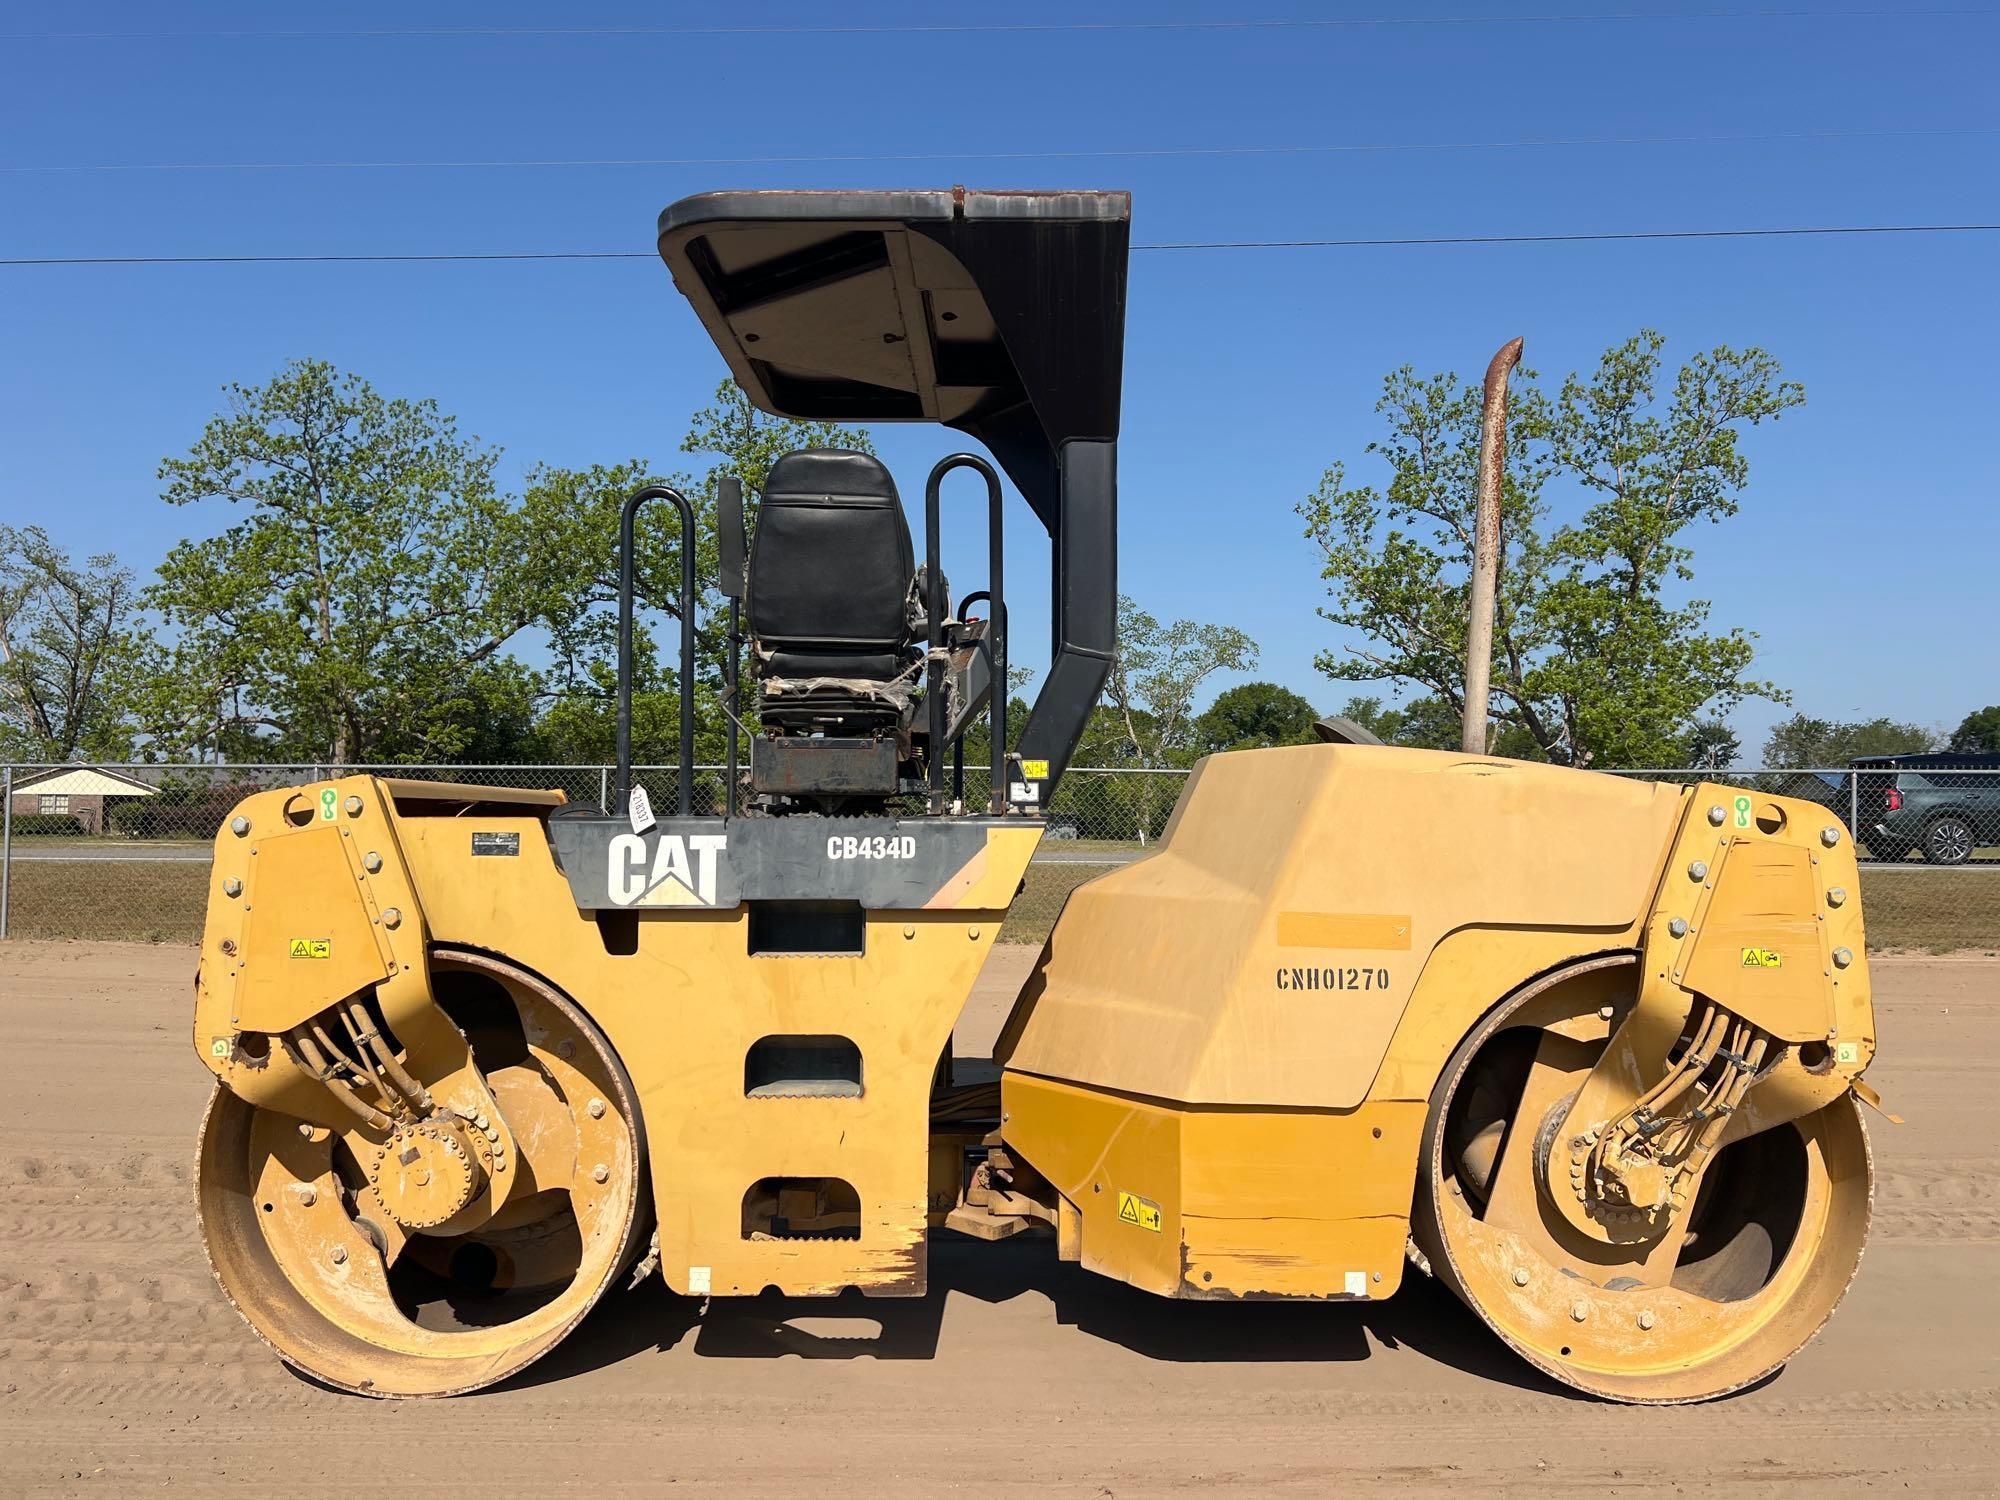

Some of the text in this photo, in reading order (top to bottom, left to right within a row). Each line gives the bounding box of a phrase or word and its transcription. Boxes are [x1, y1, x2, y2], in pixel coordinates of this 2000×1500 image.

[632, 793, 649, 822] 218337
[827, 836, 916, 860] CB434D
[608, 833, 727, 906] CAT
[1276, 968, 1389, 990] CNH01270
